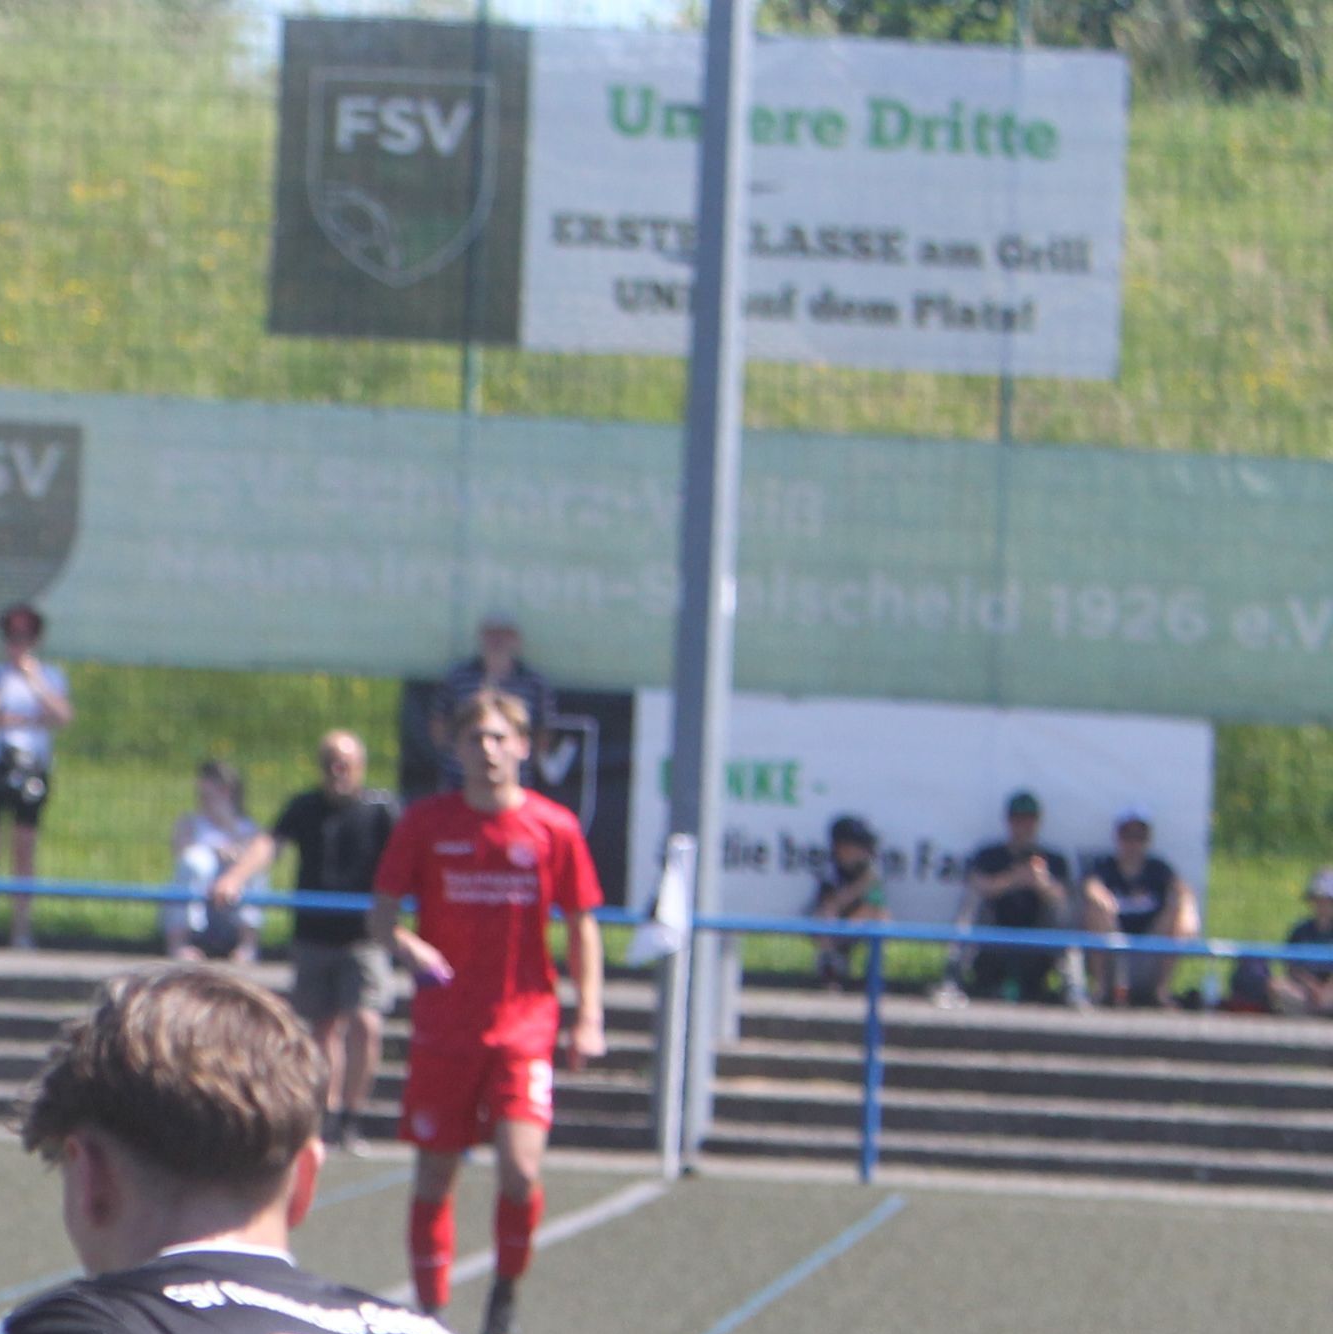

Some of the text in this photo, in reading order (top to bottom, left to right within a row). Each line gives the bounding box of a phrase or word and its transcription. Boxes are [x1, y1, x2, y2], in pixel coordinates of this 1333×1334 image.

[334, 94, 473, 159] FSV
[606, 82, 1061, 161] Unere Dritte
[745, 220, 910, 268] LASSE
[919, 239, 984, 268] am
[995, 233, 1092, 275] Grill
[613, 275, 692, 315] UN
[744, 280, 799, 322] uf
[807, 283, 901, 326] dem
[1045, 581, 1210, 646] 1926
